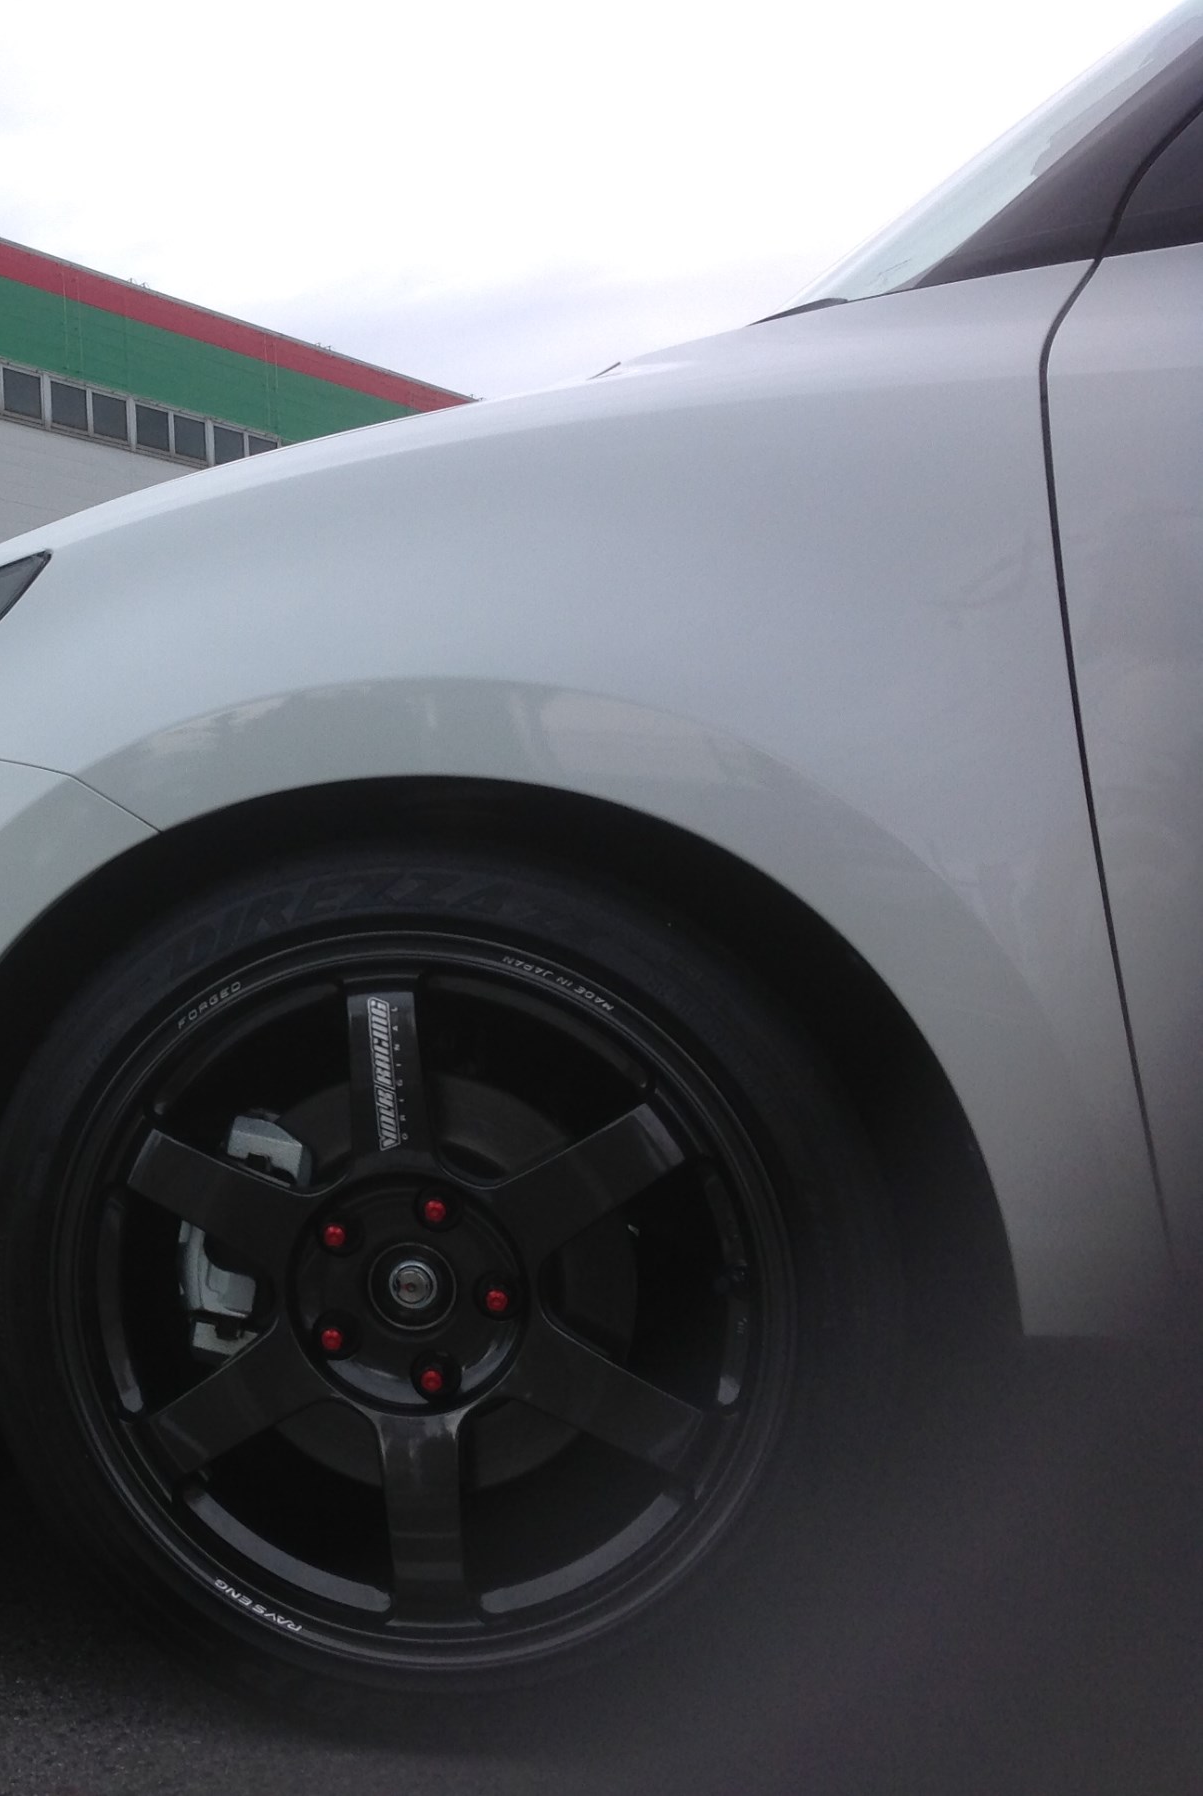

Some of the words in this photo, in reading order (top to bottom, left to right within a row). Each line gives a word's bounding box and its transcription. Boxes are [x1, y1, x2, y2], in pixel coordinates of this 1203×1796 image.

[501, 955, 555, 983] JAPAN
[556, 974, 574, 988] IN
[177, 980, 243, 1030] FORGED
[573, 984, 616, 1012] MADE
[368, 997, 396, 1091] RACING
[374, 1085, 401, 1151] VOLK
[214, 1579, 253, 1606] ENG
[252, 1603, 303, 1632] RAYS
